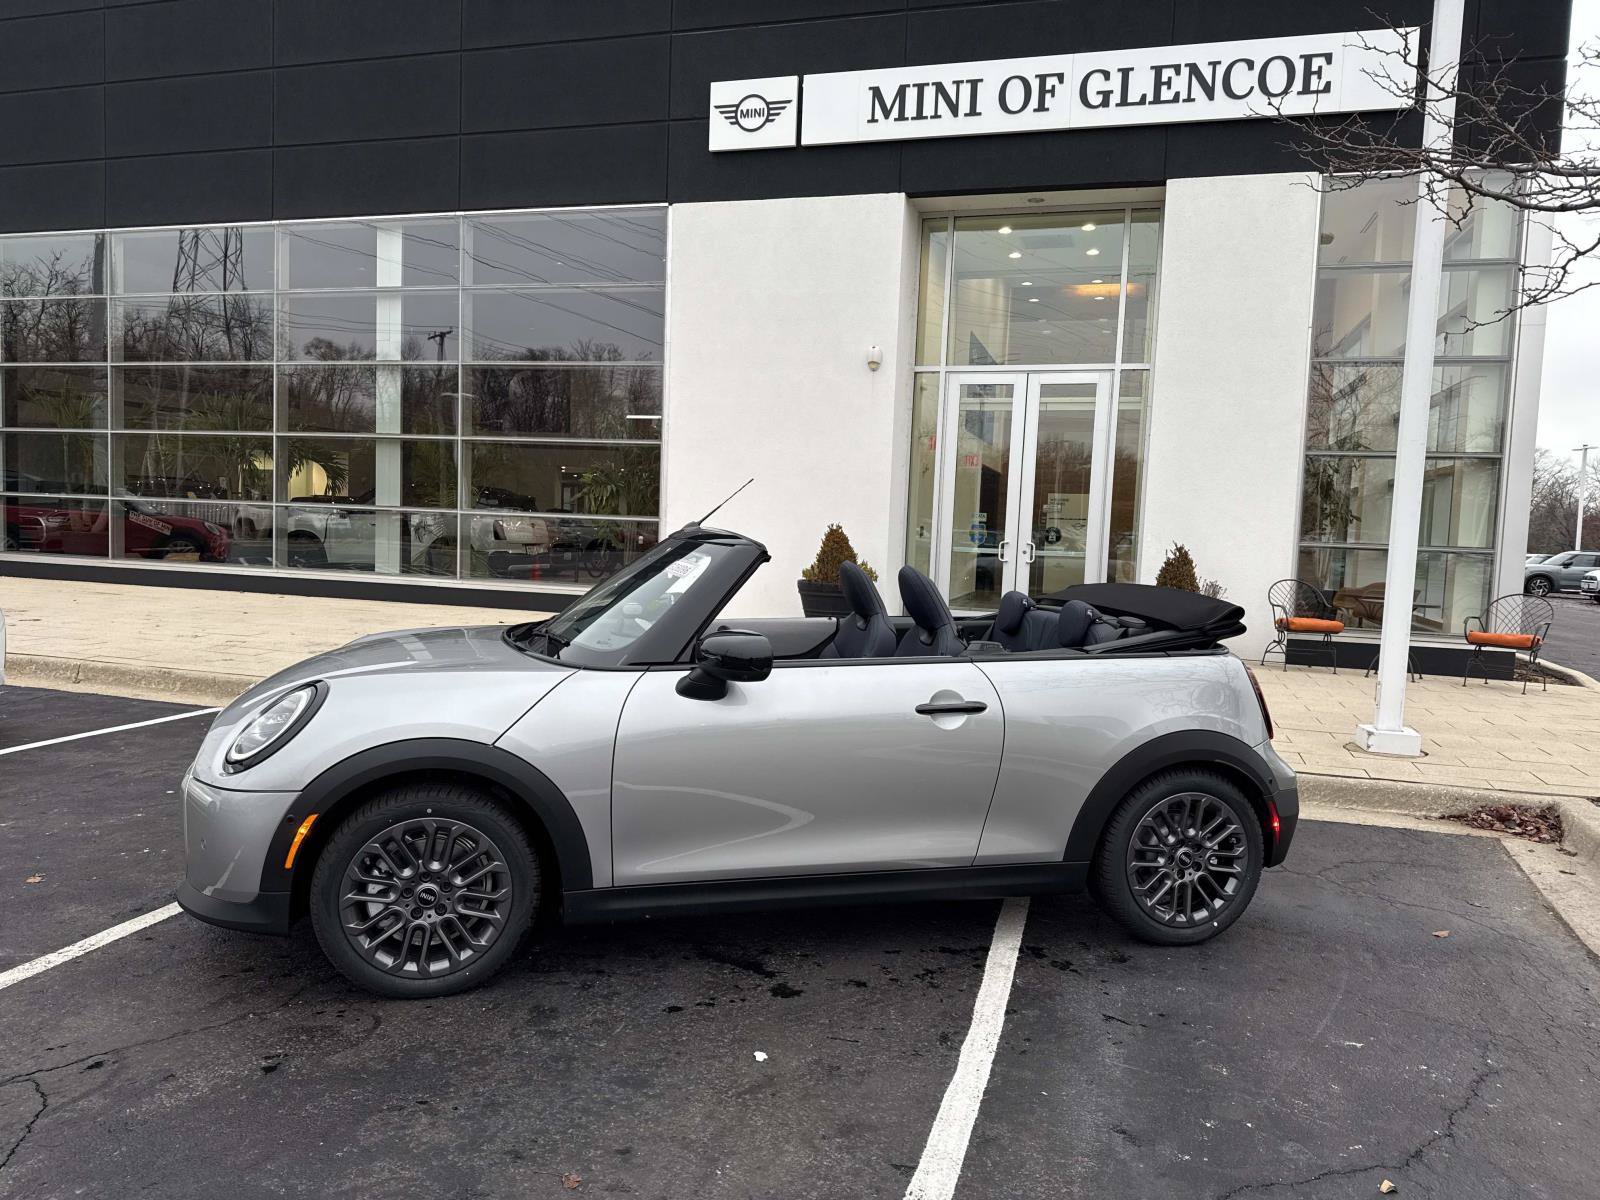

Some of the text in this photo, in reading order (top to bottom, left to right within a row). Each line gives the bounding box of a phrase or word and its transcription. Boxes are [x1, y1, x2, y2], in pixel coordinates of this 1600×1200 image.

[867, 52, 1333, 123] MINI OF GLENCOE
[739, 106, 765, 120] MINI
